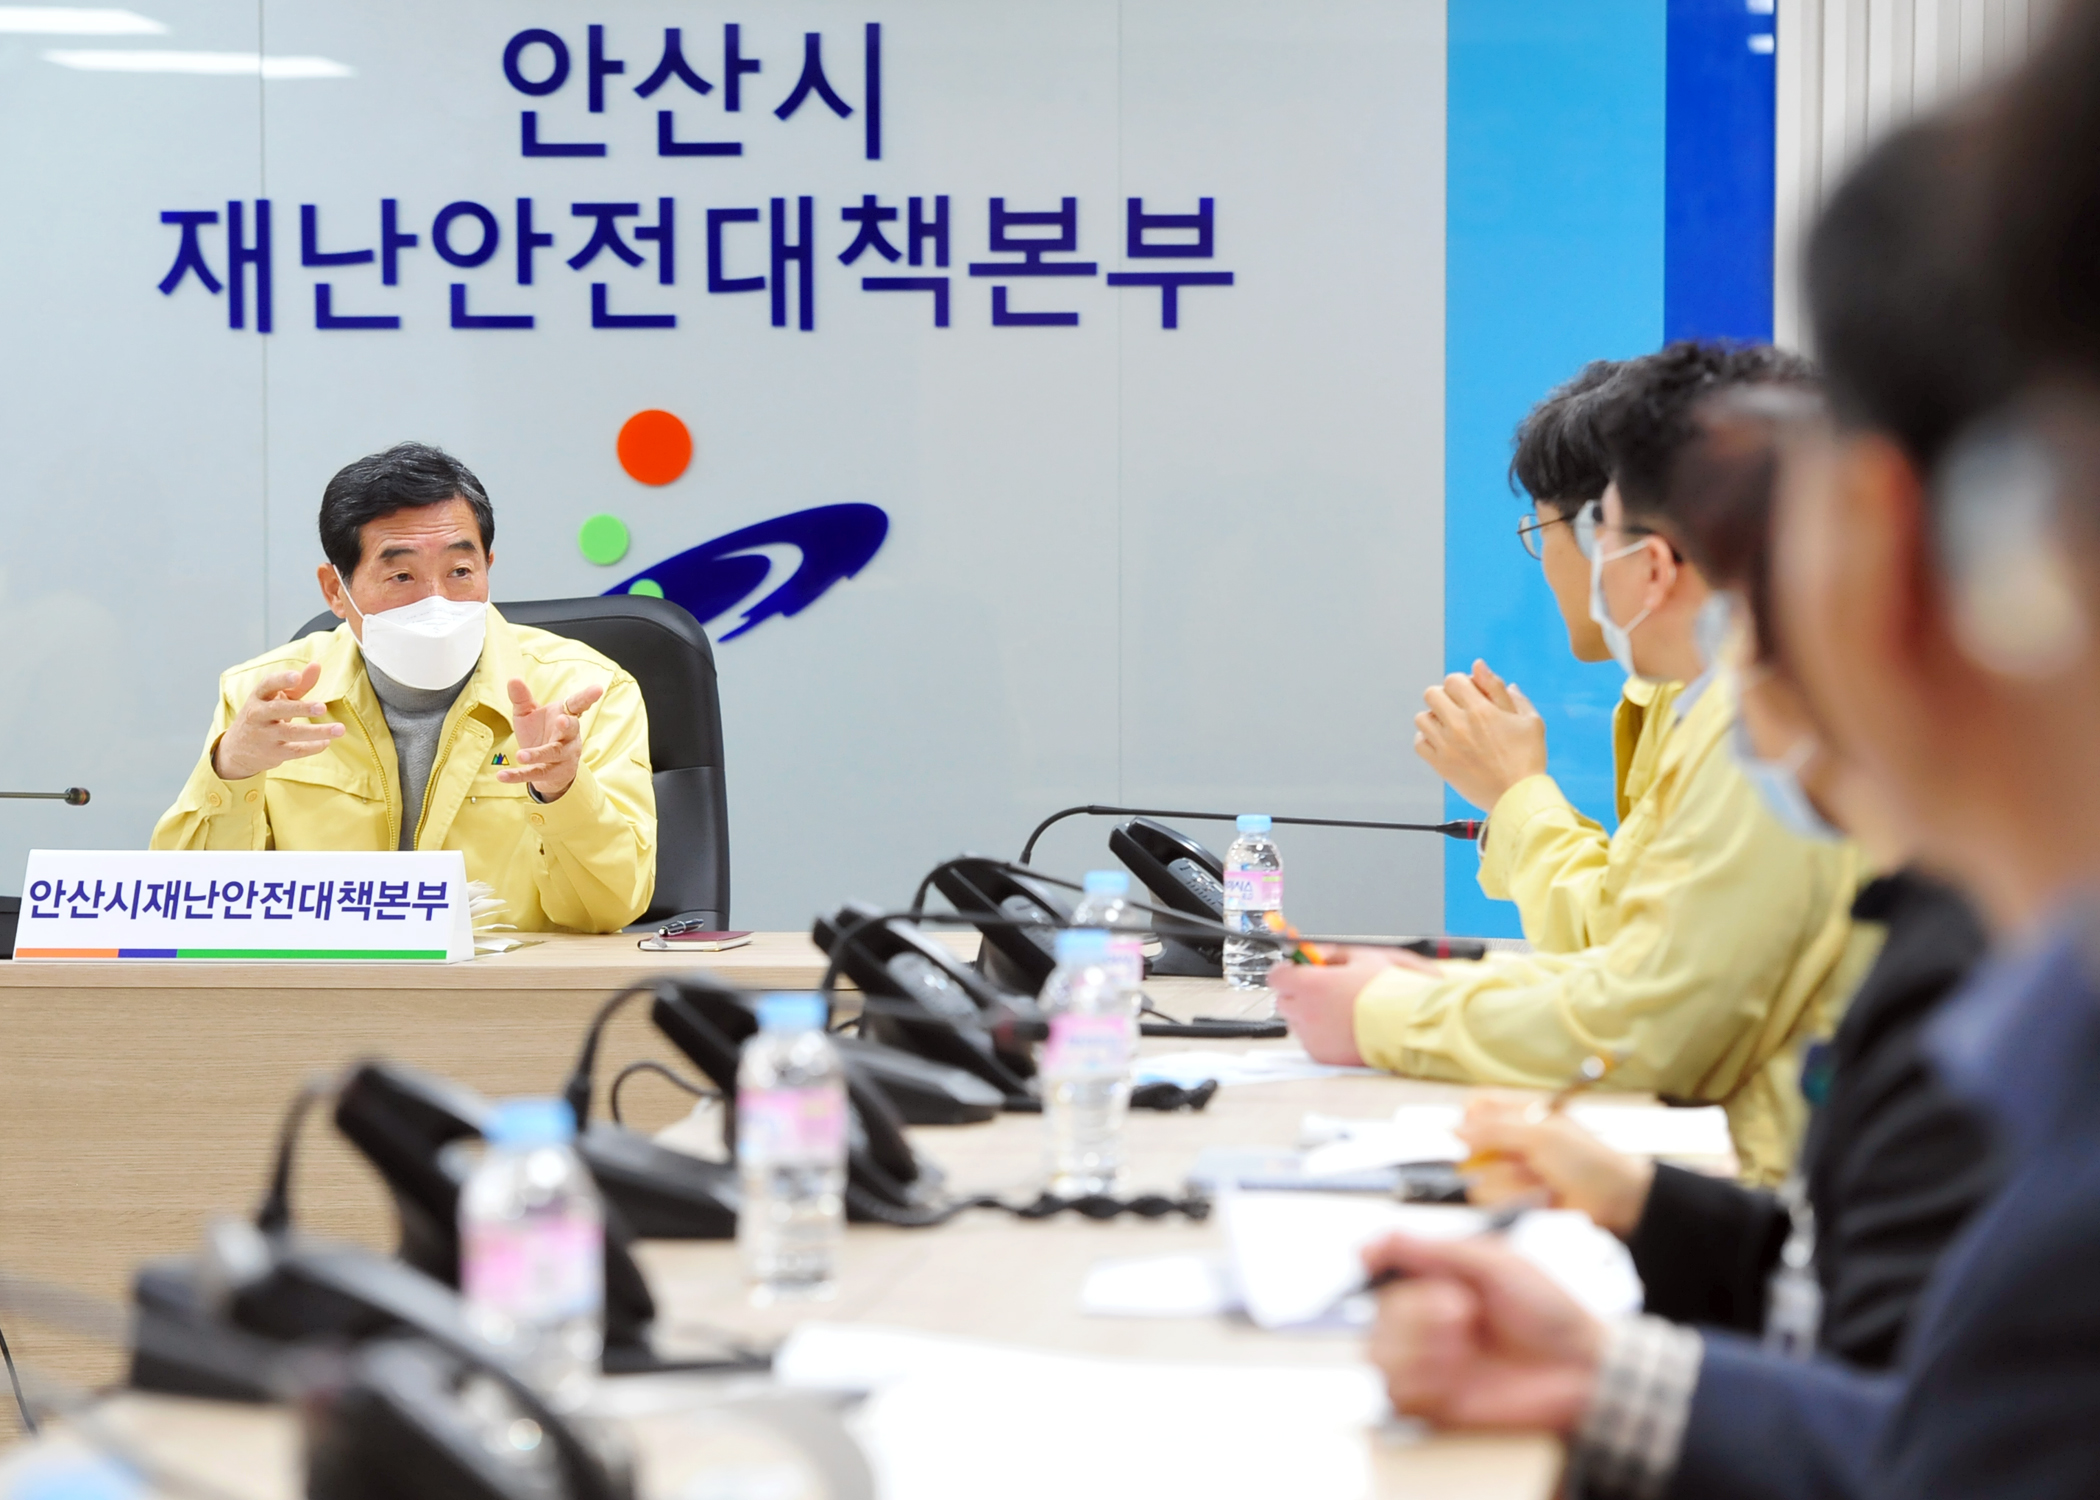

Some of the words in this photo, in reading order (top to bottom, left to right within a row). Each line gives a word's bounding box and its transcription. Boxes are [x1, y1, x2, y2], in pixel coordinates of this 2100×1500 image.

[502, 22, 884, 161] 안산시
[157, 194, 1234, 335] 재난안전대책본부
[29, 879, 449, 921] 안산시재난안전대책본부
